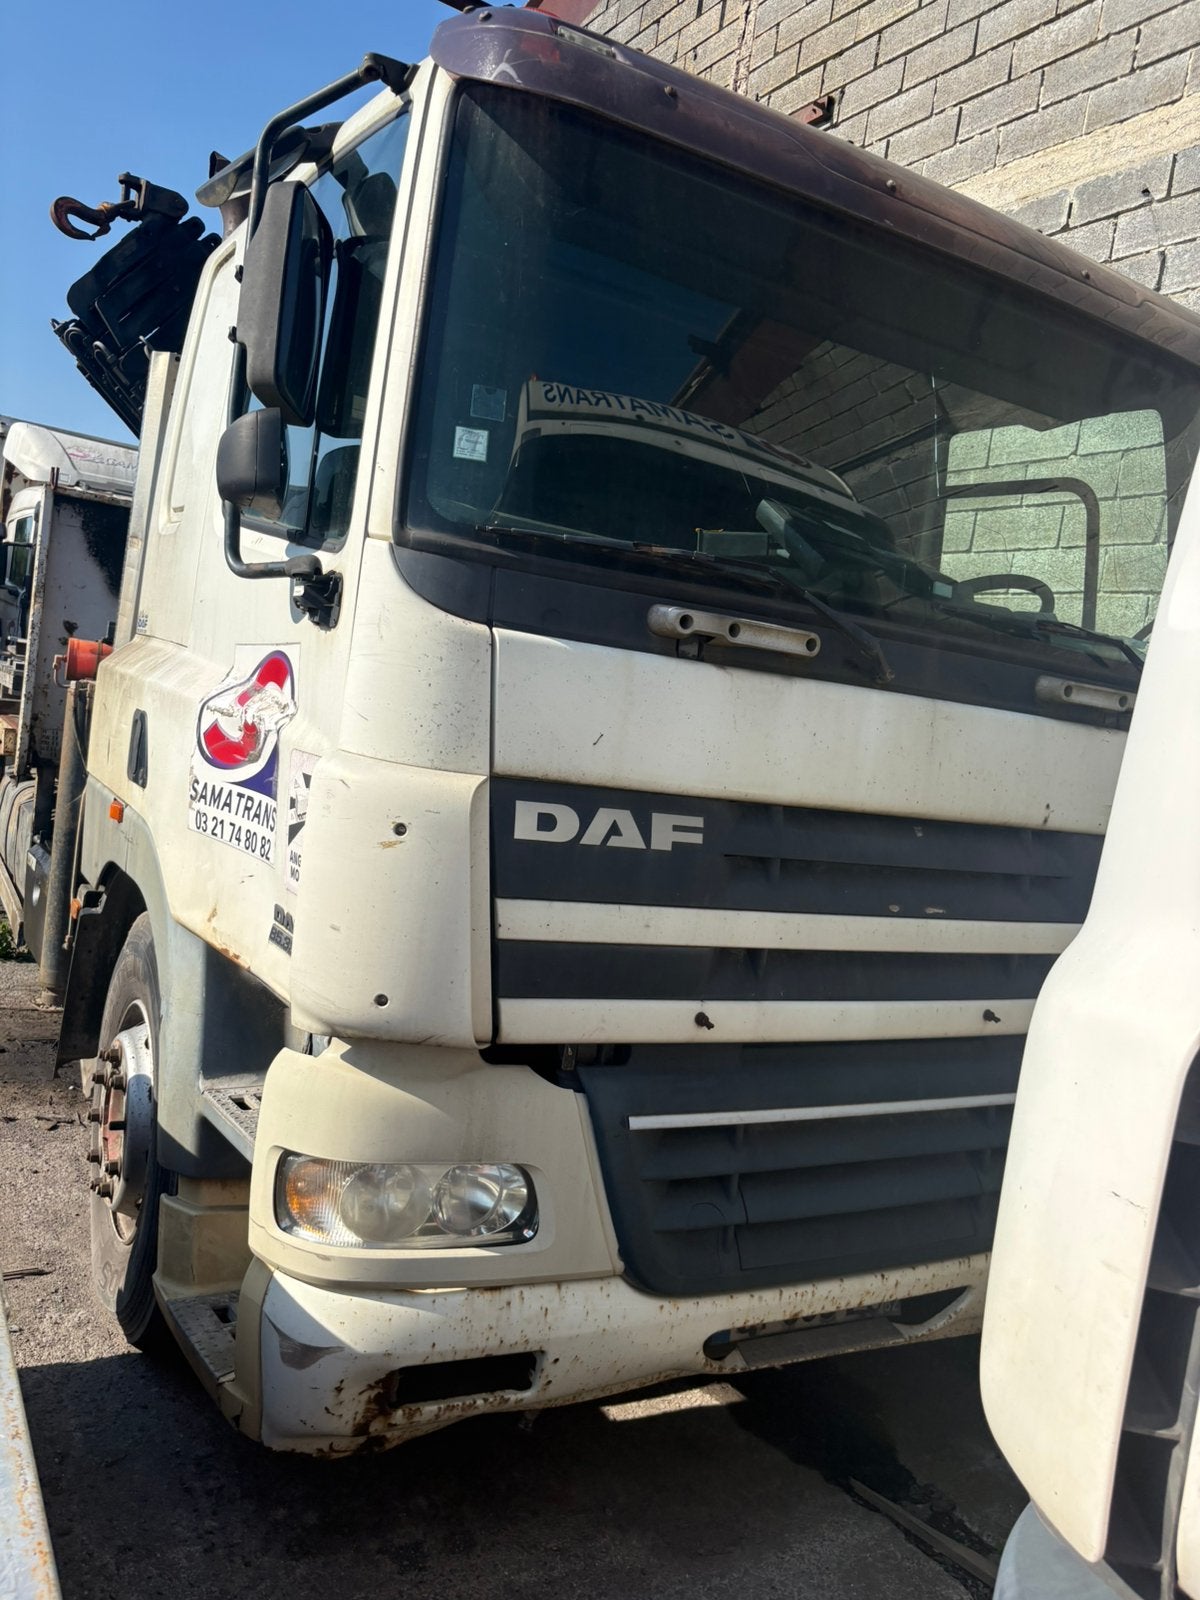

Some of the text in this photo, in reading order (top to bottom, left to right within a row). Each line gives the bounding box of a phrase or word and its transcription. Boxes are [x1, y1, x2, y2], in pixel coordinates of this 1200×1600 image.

[190, 778, 277, 832] SAMATRANS
[514, 800, 704, 851] DAF
[195, 809, 271, 861] 03 21 74 80 82
